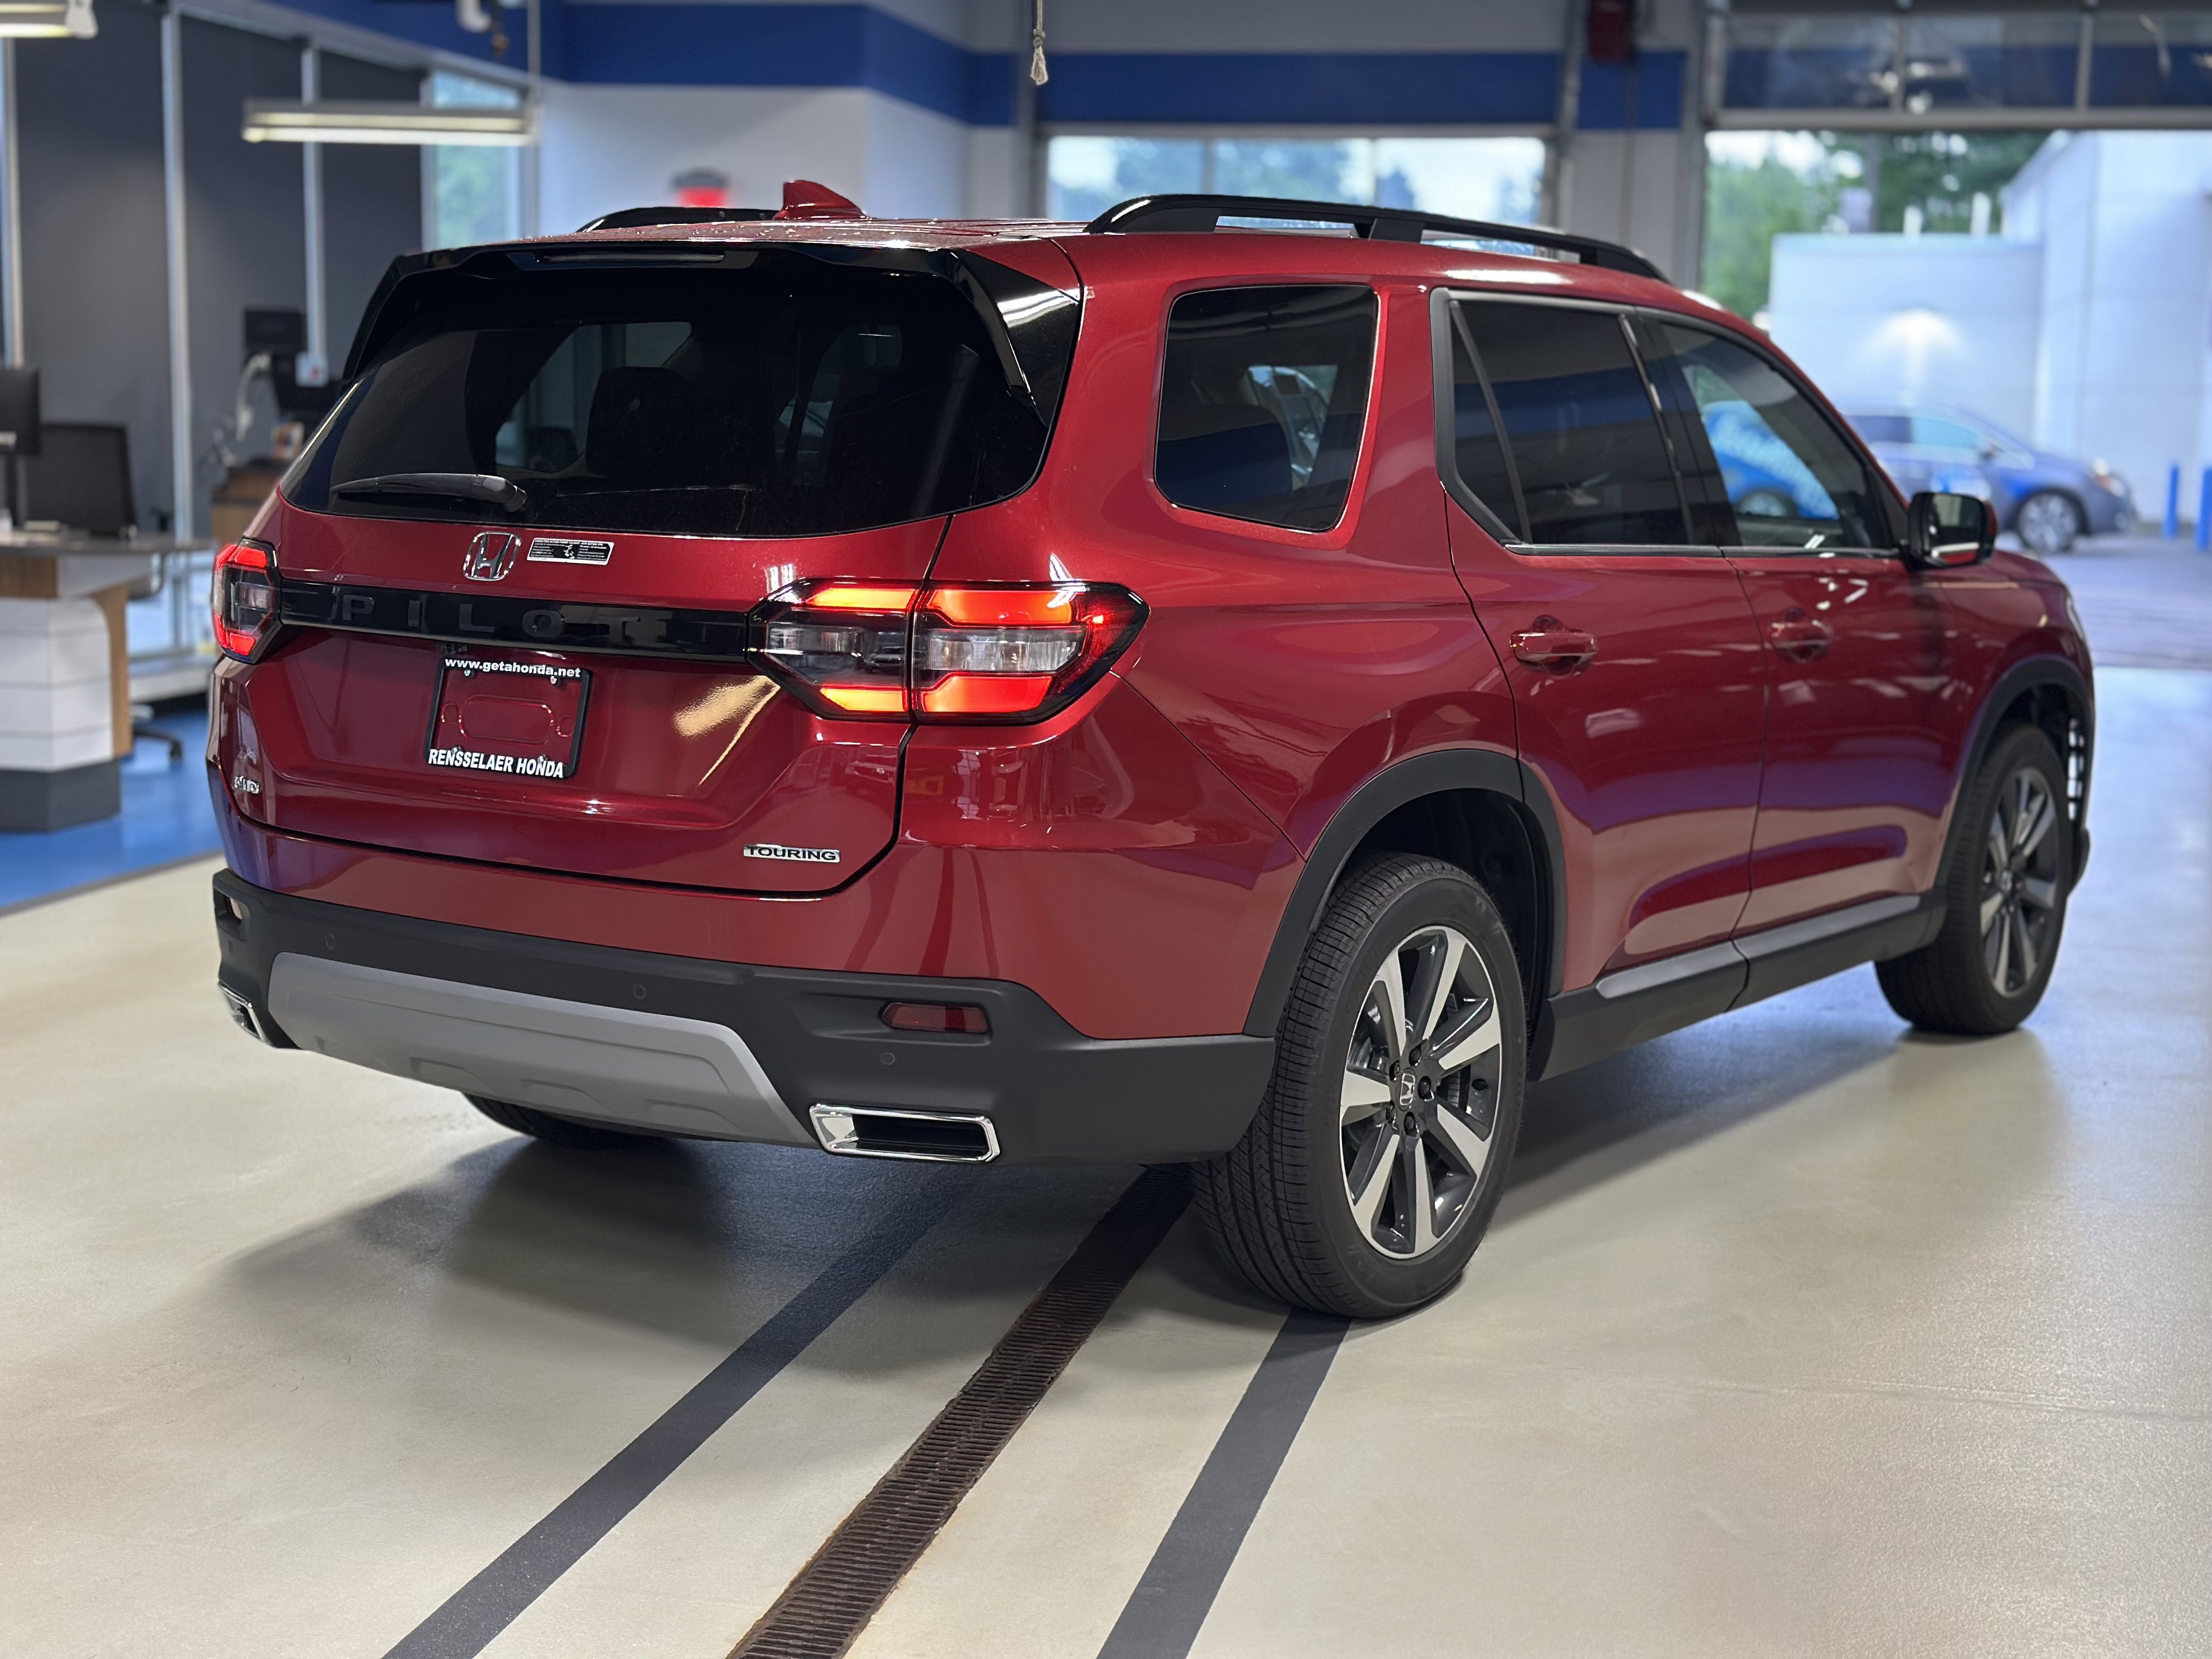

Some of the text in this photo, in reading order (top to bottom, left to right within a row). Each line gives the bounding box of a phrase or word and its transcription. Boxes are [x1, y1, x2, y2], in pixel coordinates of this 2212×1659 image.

[341, 594, 641, 644] PILOT
[444, 658, 581, 678] www.getahonda.net
[428, 749, 563, 778] RENSSELAER HONDA
[747, 847, 836, 861] TOURING
